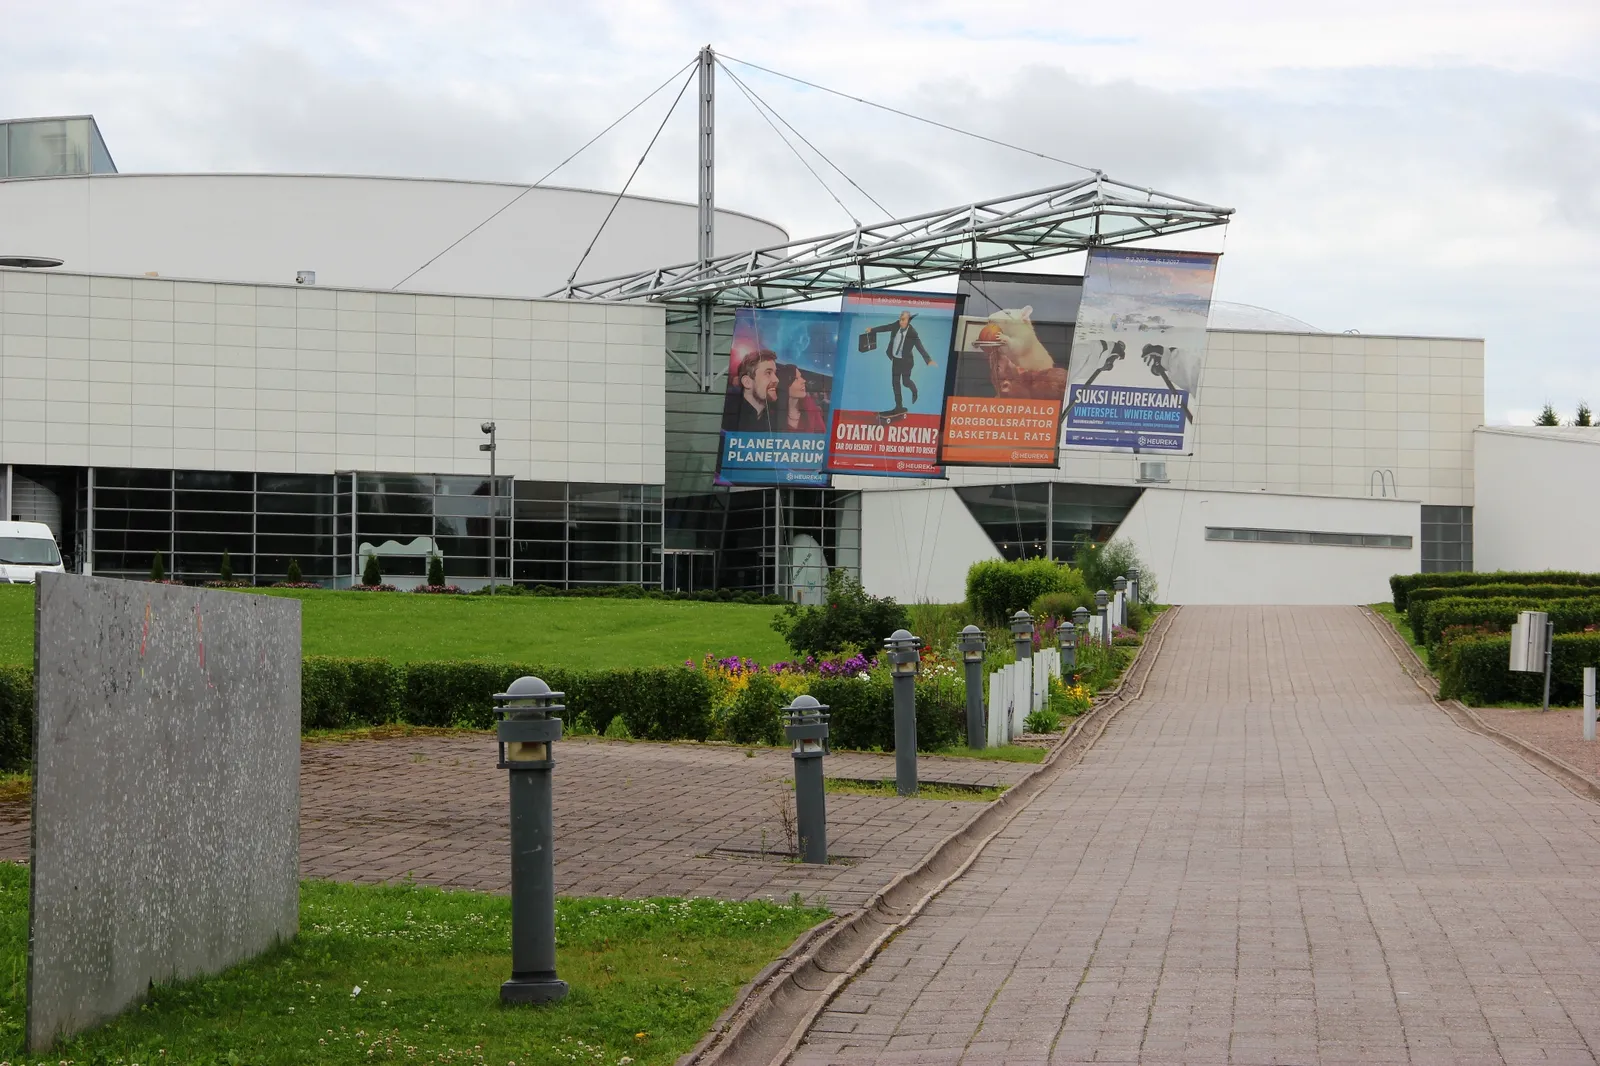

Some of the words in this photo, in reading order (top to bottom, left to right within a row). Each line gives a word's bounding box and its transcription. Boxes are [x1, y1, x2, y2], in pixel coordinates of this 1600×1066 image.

[1075, 389, 1108, 404] SUKSI
[1110, 390, 1182, 408] HEUREKAAN!
[951, 403, 1054, 415] ROTTAKORIPALLO
[1074, 406, 1118, 418] VINTERSPEL
[1124, 409, 1152, 420] WINTER
[1154, 410, 1180, 421] GAMES
[950, 416, 1053, 428] KORGBOLLSRÅTTOR
[836, 423, 885, 442] OTATKO
[887, 426, 939, 444] RISKIN?
[949, 430, 1019, 440] BASKETBALL
[1024, 432, 1051, 441] RATS
[729, 438, 825, 450] PLANETAARIO
[853, 443, 872, 451] RISKEN?
[1146, 438, 1178, 446] HEUREKA
[886, 445, 897, 453] RISK
[922, 447, 936, 455] RISK?
[728, 451, 824, 463] PLANETARIUM
